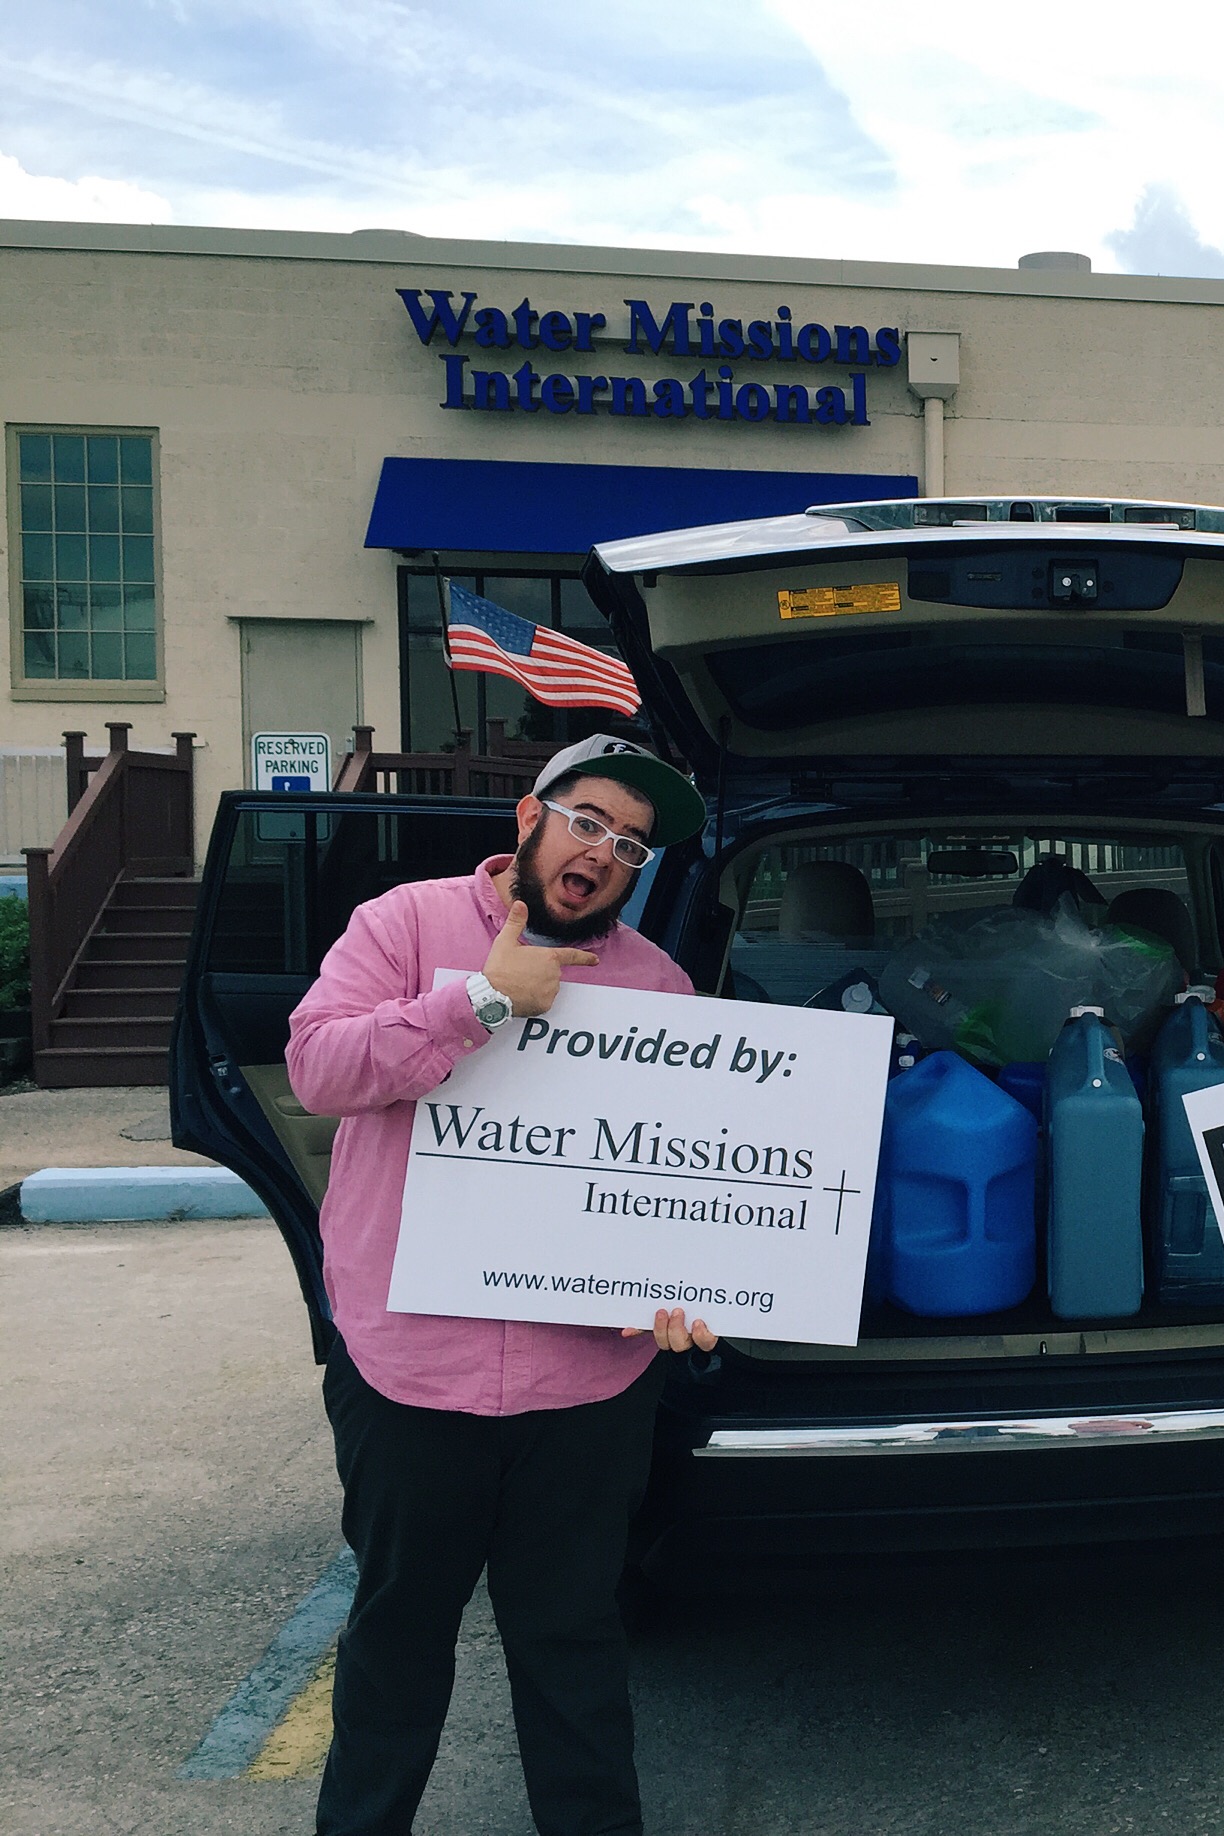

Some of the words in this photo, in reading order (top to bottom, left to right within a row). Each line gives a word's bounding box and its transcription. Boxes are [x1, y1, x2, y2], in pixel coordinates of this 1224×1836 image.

[395, 288, 606, 352] Water
[624, 299, 901, 367] Missions
[439, 353, 871, 426] International
[257, 741, 325, 755] RESERVED
[265, 760, 319, 773] PARKING
[516, 1017, 721, 1070] Provided
[730, 1037, 798, 1083] by:
[424, 1102, 576, 1158] Water
[589, 1117, 814, 1179] Missions
[582, 1181, 808, 1231] International
[482, 1270, 774, 1313] www.watermissions.org
